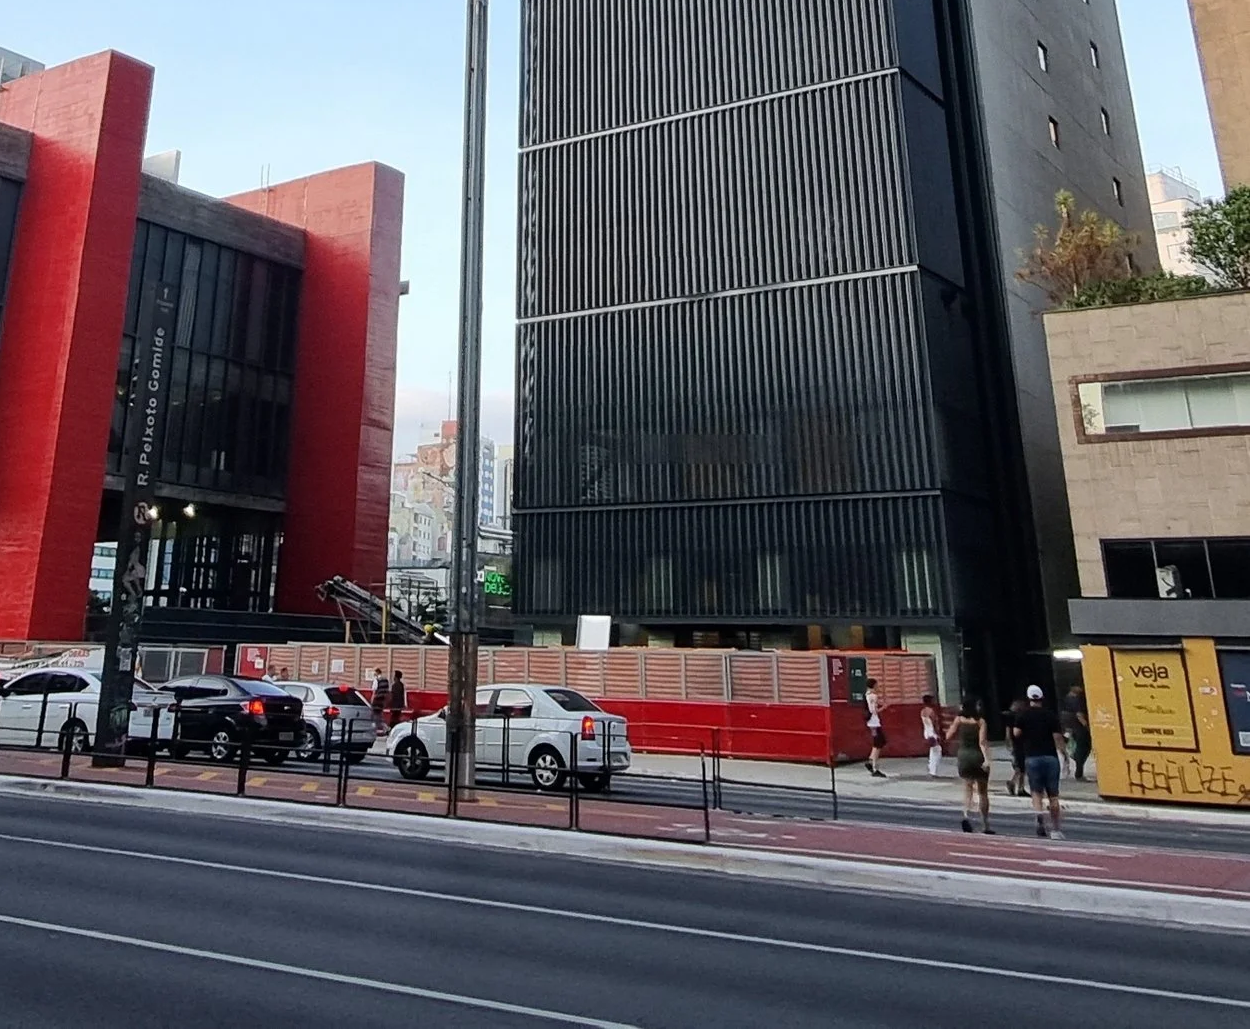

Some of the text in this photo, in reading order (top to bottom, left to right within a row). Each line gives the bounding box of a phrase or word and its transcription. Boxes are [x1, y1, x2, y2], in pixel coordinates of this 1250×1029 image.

[137, 327, 165, 486] R. Peixoto Gomide
[1129, 662, 1169, 682] veja
